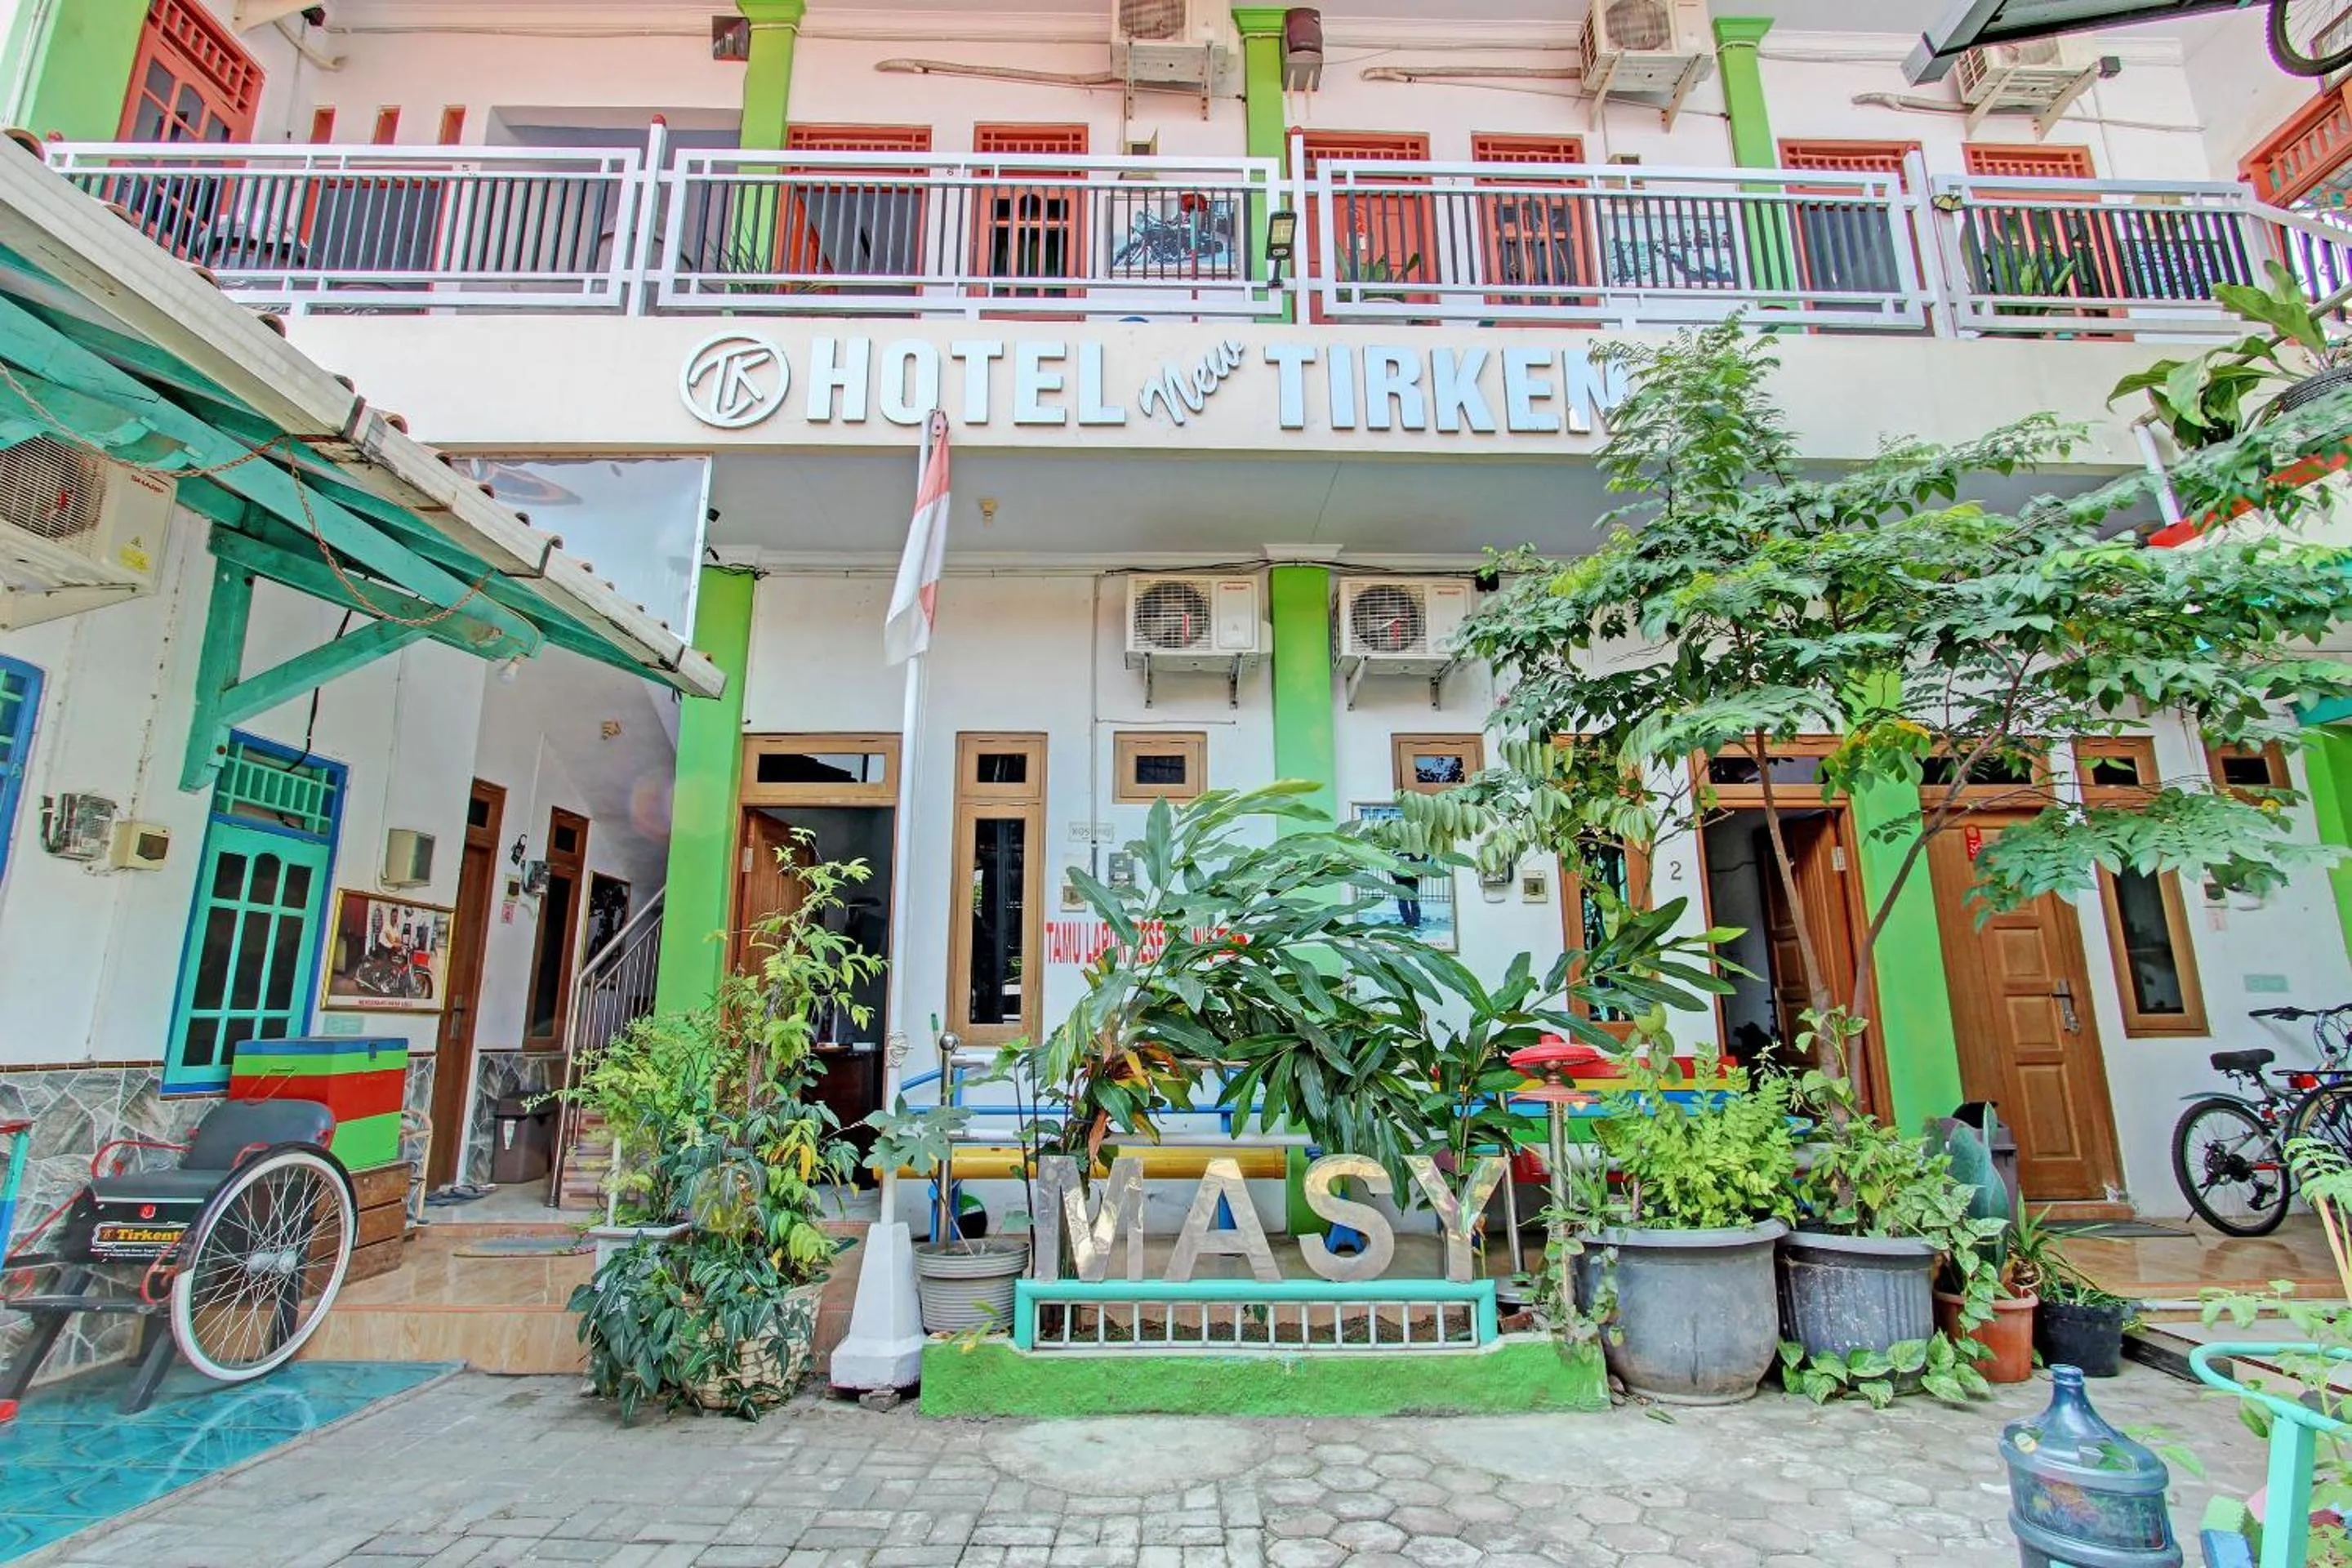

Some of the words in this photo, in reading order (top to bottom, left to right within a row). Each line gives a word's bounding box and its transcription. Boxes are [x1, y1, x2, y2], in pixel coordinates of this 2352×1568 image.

[805, 337, 1126, 426] HOTEL
[1139, 340, 1246, 426] New
[1669, 860, 1682, 880] 2
[1046, 922, 1081, 964] TAMU
[1033, 1154, 1508, 1282] MASY
